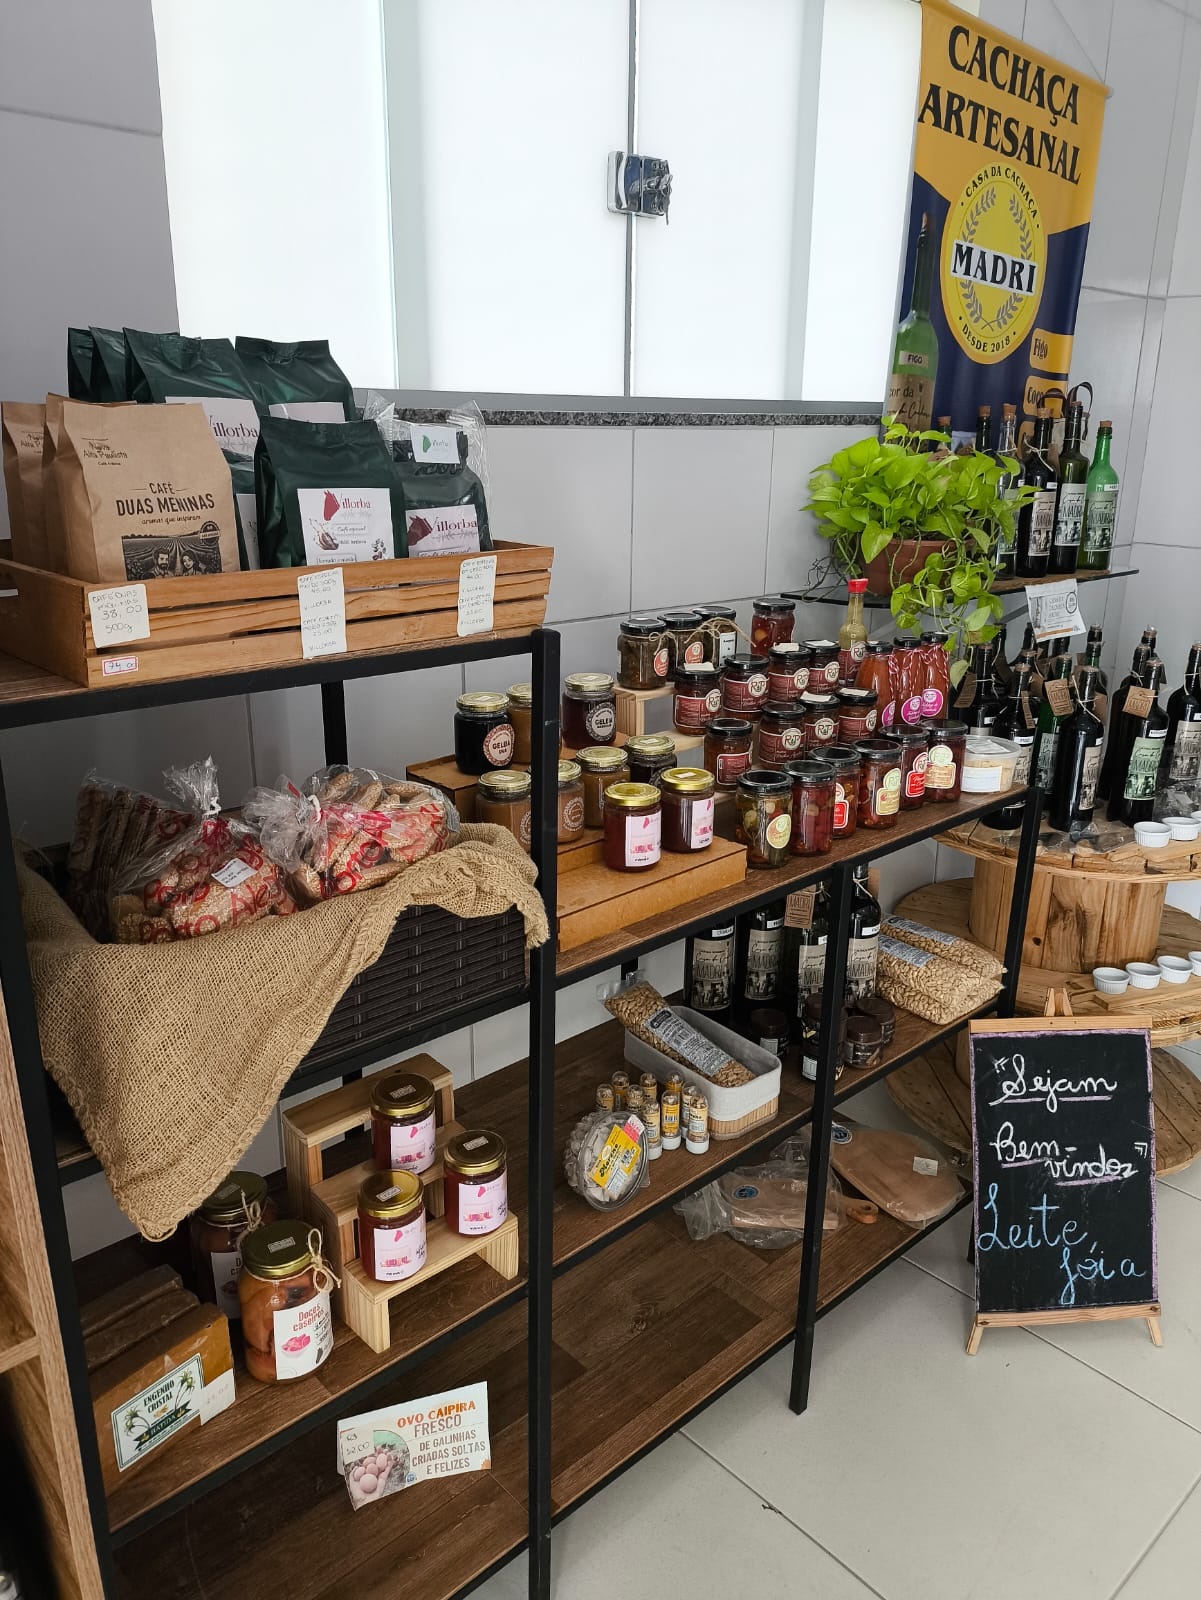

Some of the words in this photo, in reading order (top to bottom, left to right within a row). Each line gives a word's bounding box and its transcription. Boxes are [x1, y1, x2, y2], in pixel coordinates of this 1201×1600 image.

[949, 25, 1080, 127] CACHAÇA
[917, 83, 1082, 185] ARTESANAL
[965, 169, 989, 198] CASA
[991, 165, 1002, 177] DA
[1004, 167, 1038, 219] CACHAÇA
[952, 243, 1036, 293] MADRI
[962, 324, 988, 352] DESDE
[990, 335, 1011, 353] 2018
[1033, 338, 1048, 360] Figo
[907, 353, 923, 364] FIGO
[149, 481, 176, 495] CAFÉ
[116, 497, 154, 517] DUAS
[156, 493, 216, 513] MENINAS
[165, 516, 176, 525] que
[298, 1302, 321, 1322] Doces
[143, 1379, 175, 1407] ENGENHO
[147, 1391, 173, 1414] CRISTAL
[396, 1413, 424, 1428] OVO
[428, 1400, 476, 1420] CAIPIRA
[414, 1414, 462, 1438] FRESCO
[419, 1440, 431, 1452] DE
[433, 1430, 477, 1448] GALINHAS
[412, 1449, 449, 1467] CRIADAS
[452, 1441, 486, 1458] SOLTAS
[426, 1465, 432, 1474] E
[434, 1458, 471, 1474] FELIZES
